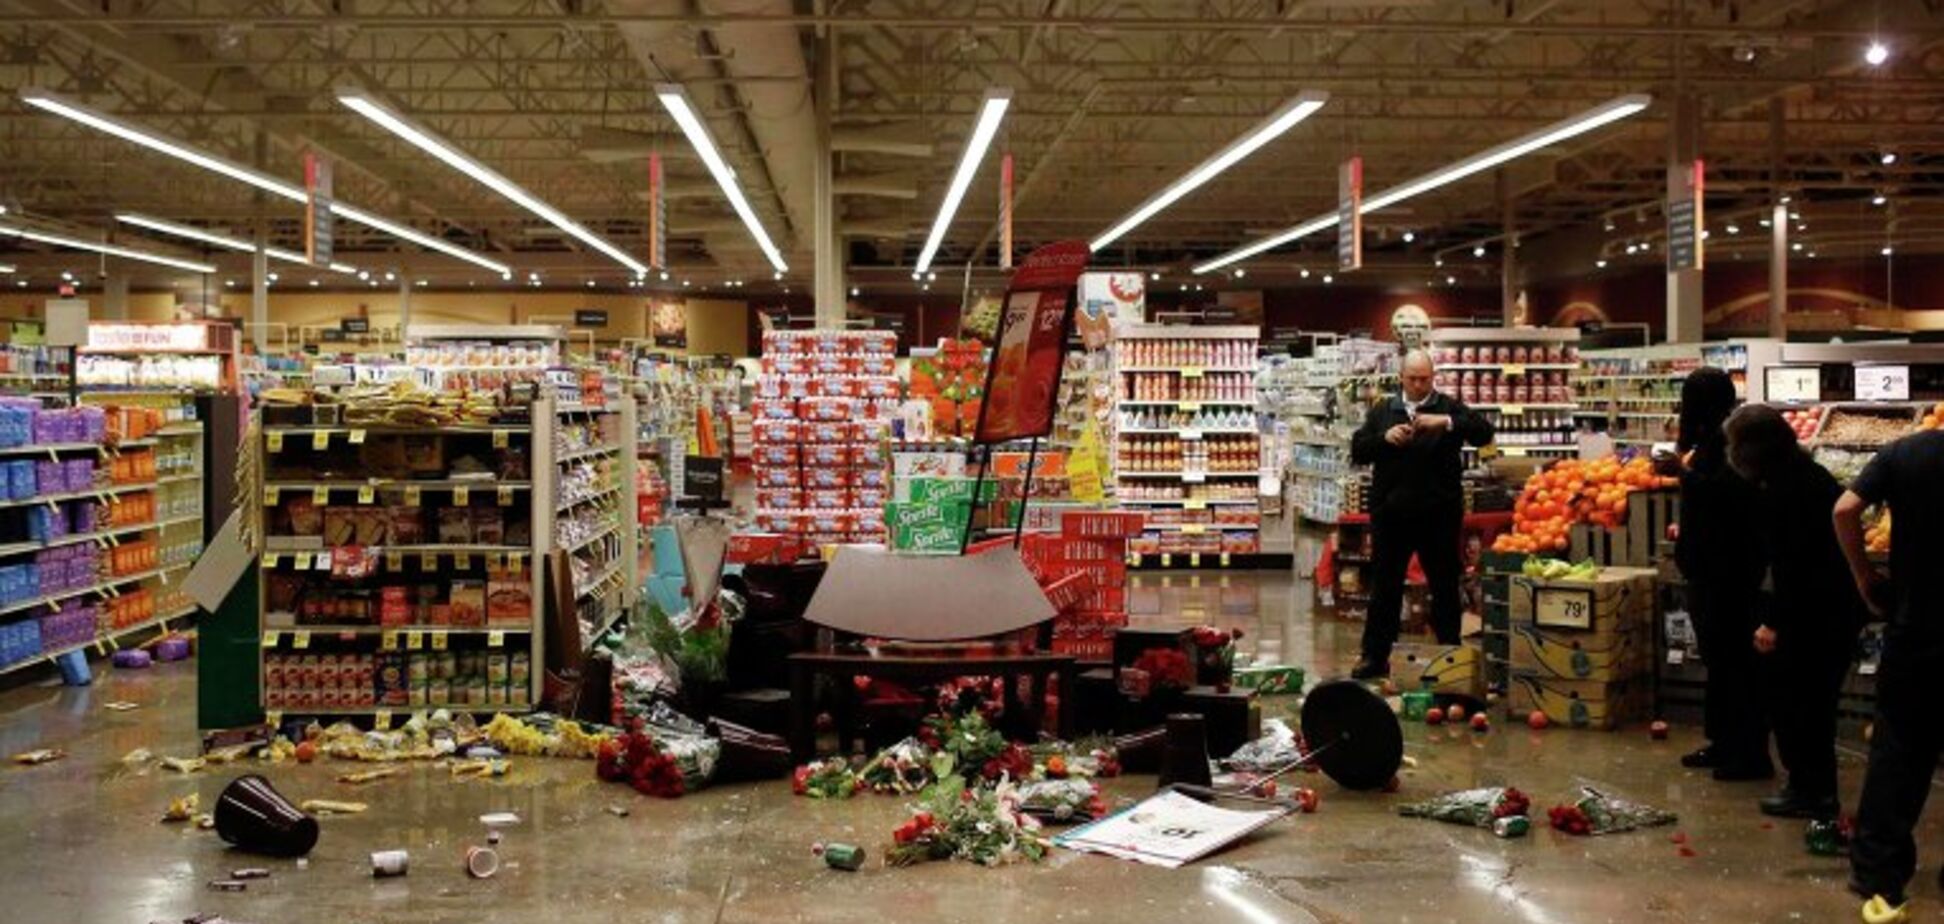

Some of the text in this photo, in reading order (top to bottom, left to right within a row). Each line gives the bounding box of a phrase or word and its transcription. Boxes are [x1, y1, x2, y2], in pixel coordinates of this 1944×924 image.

[927, 481, 967, 502] Sprite
[899, 505, 939, 524] Sprite
[913, 526, 955, 547] Sprite
